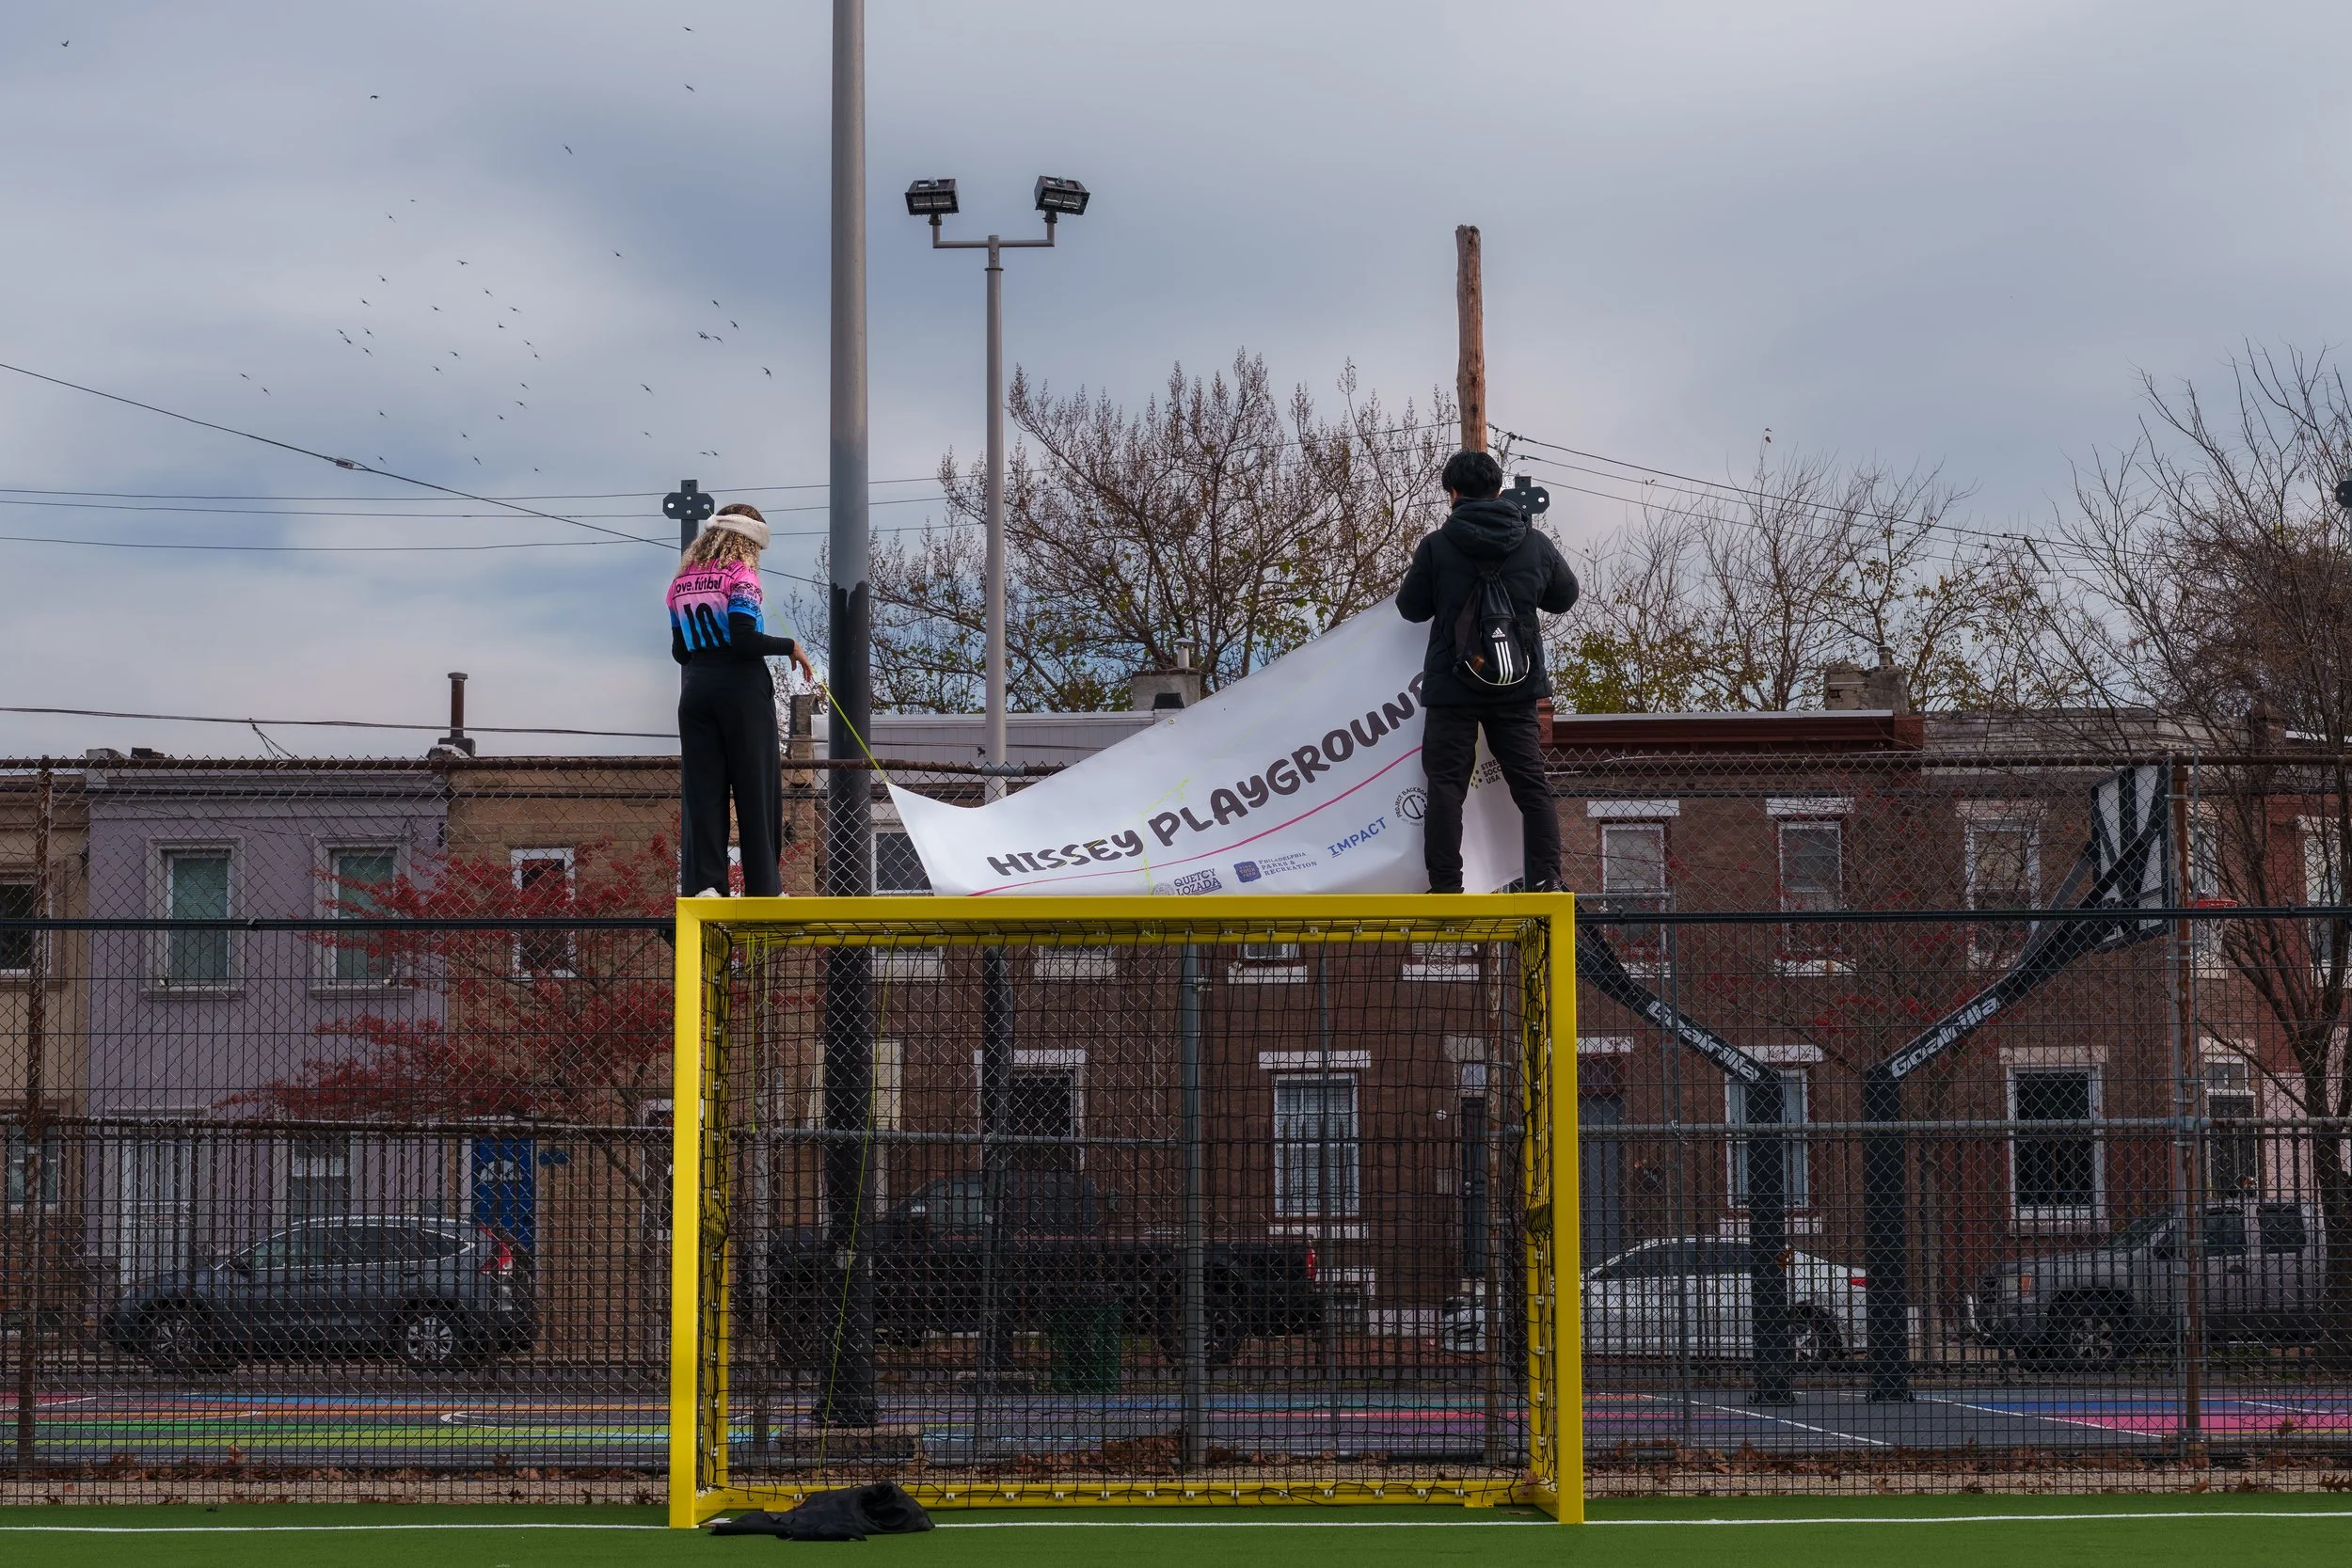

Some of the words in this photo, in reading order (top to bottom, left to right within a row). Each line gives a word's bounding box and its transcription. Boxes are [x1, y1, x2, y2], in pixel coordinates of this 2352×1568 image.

[1481, 759, 1498, 770] STRE
[1484, 766, 1502, 778] SOCC
[1486, 774, 1501, 784] USA
[1394, 794, 1404, 818] PROJECT
[1401, 786, 1427, 798] BACKBOA
[1327, 816, 1387, 857] IMPACT
[987, 830, 1144, 876] HISSEY
[1259, 851, 1306, 864] PHILADELPHIA
[1262, 862, 1288, 870] PARKS
[1263, 861, 1317, 876] RECREATION
[1174, 868, 1216, 887] QUETCY
[1177, 877, 1220, 895] LOZADA
